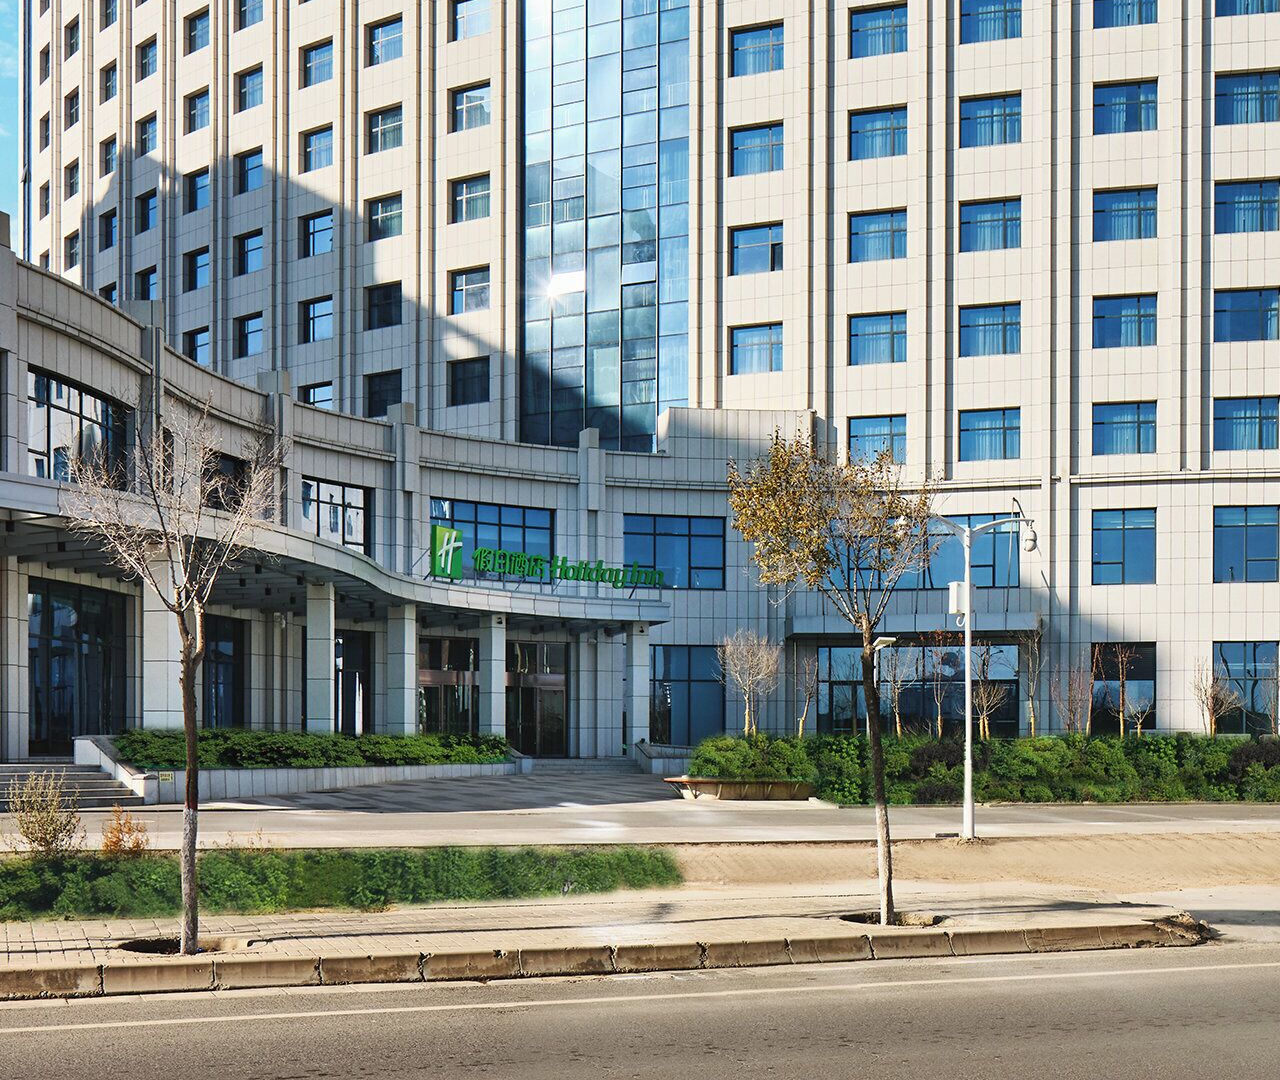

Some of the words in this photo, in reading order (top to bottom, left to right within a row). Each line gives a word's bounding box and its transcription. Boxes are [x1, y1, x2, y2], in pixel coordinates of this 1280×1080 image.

[473, 547, 546, 578] 假日酒店
[550, 555, 628, 589] Holiday
[630, 560, 664, 586] Inn
